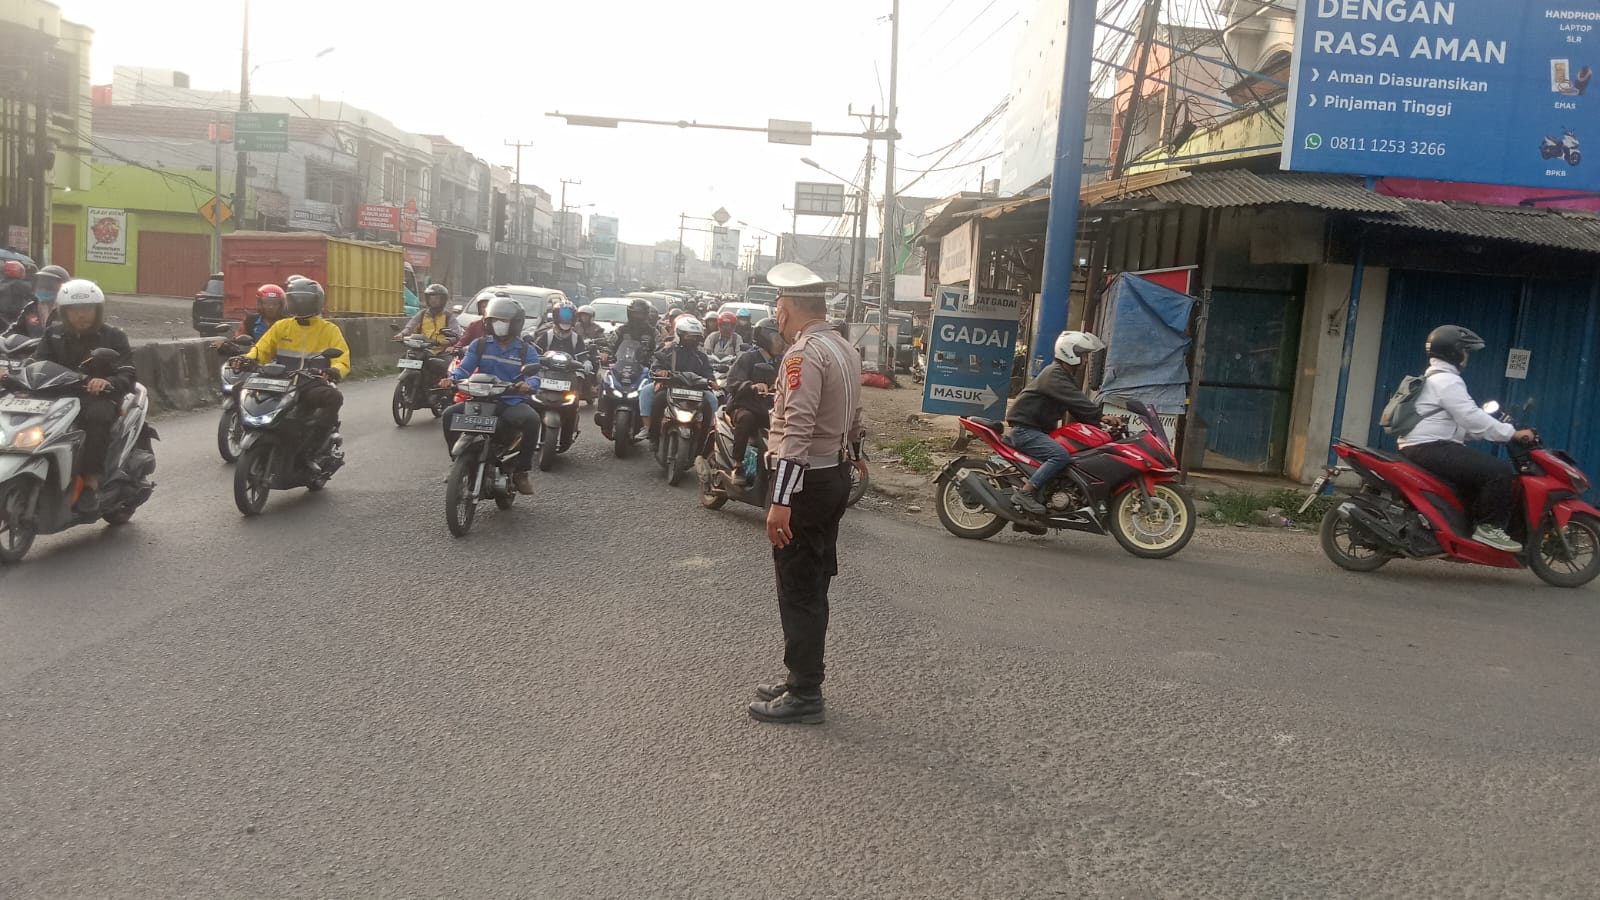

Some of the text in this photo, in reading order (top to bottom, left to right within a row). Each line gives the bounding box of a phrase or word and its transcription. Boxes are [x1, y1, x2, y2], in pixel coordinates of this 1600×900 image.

[1317, 0, 1455, 25] DENGAN
[1559, 24, 1593, 32] LAPTOP
[1314, 30, 1507, 64] RASA AMAN
[1566, 35, 1582, 43] SLR
[1327, 70, 1488, 92] Aman Diasuransikan
[1324, 95, 1452, 117] Pinjaman Tinggi
[1554, 102, 1576, 110] EMAS
[1330, 136, 1446, 156] 0811 1253 3266
[1545, 169, 1567, 177] BPKB
[962, 294, 1018, 309] PSAT GADAI
[940, 324, 1009, 348] GADAI
[934, 387, 983, 401] MASUK
